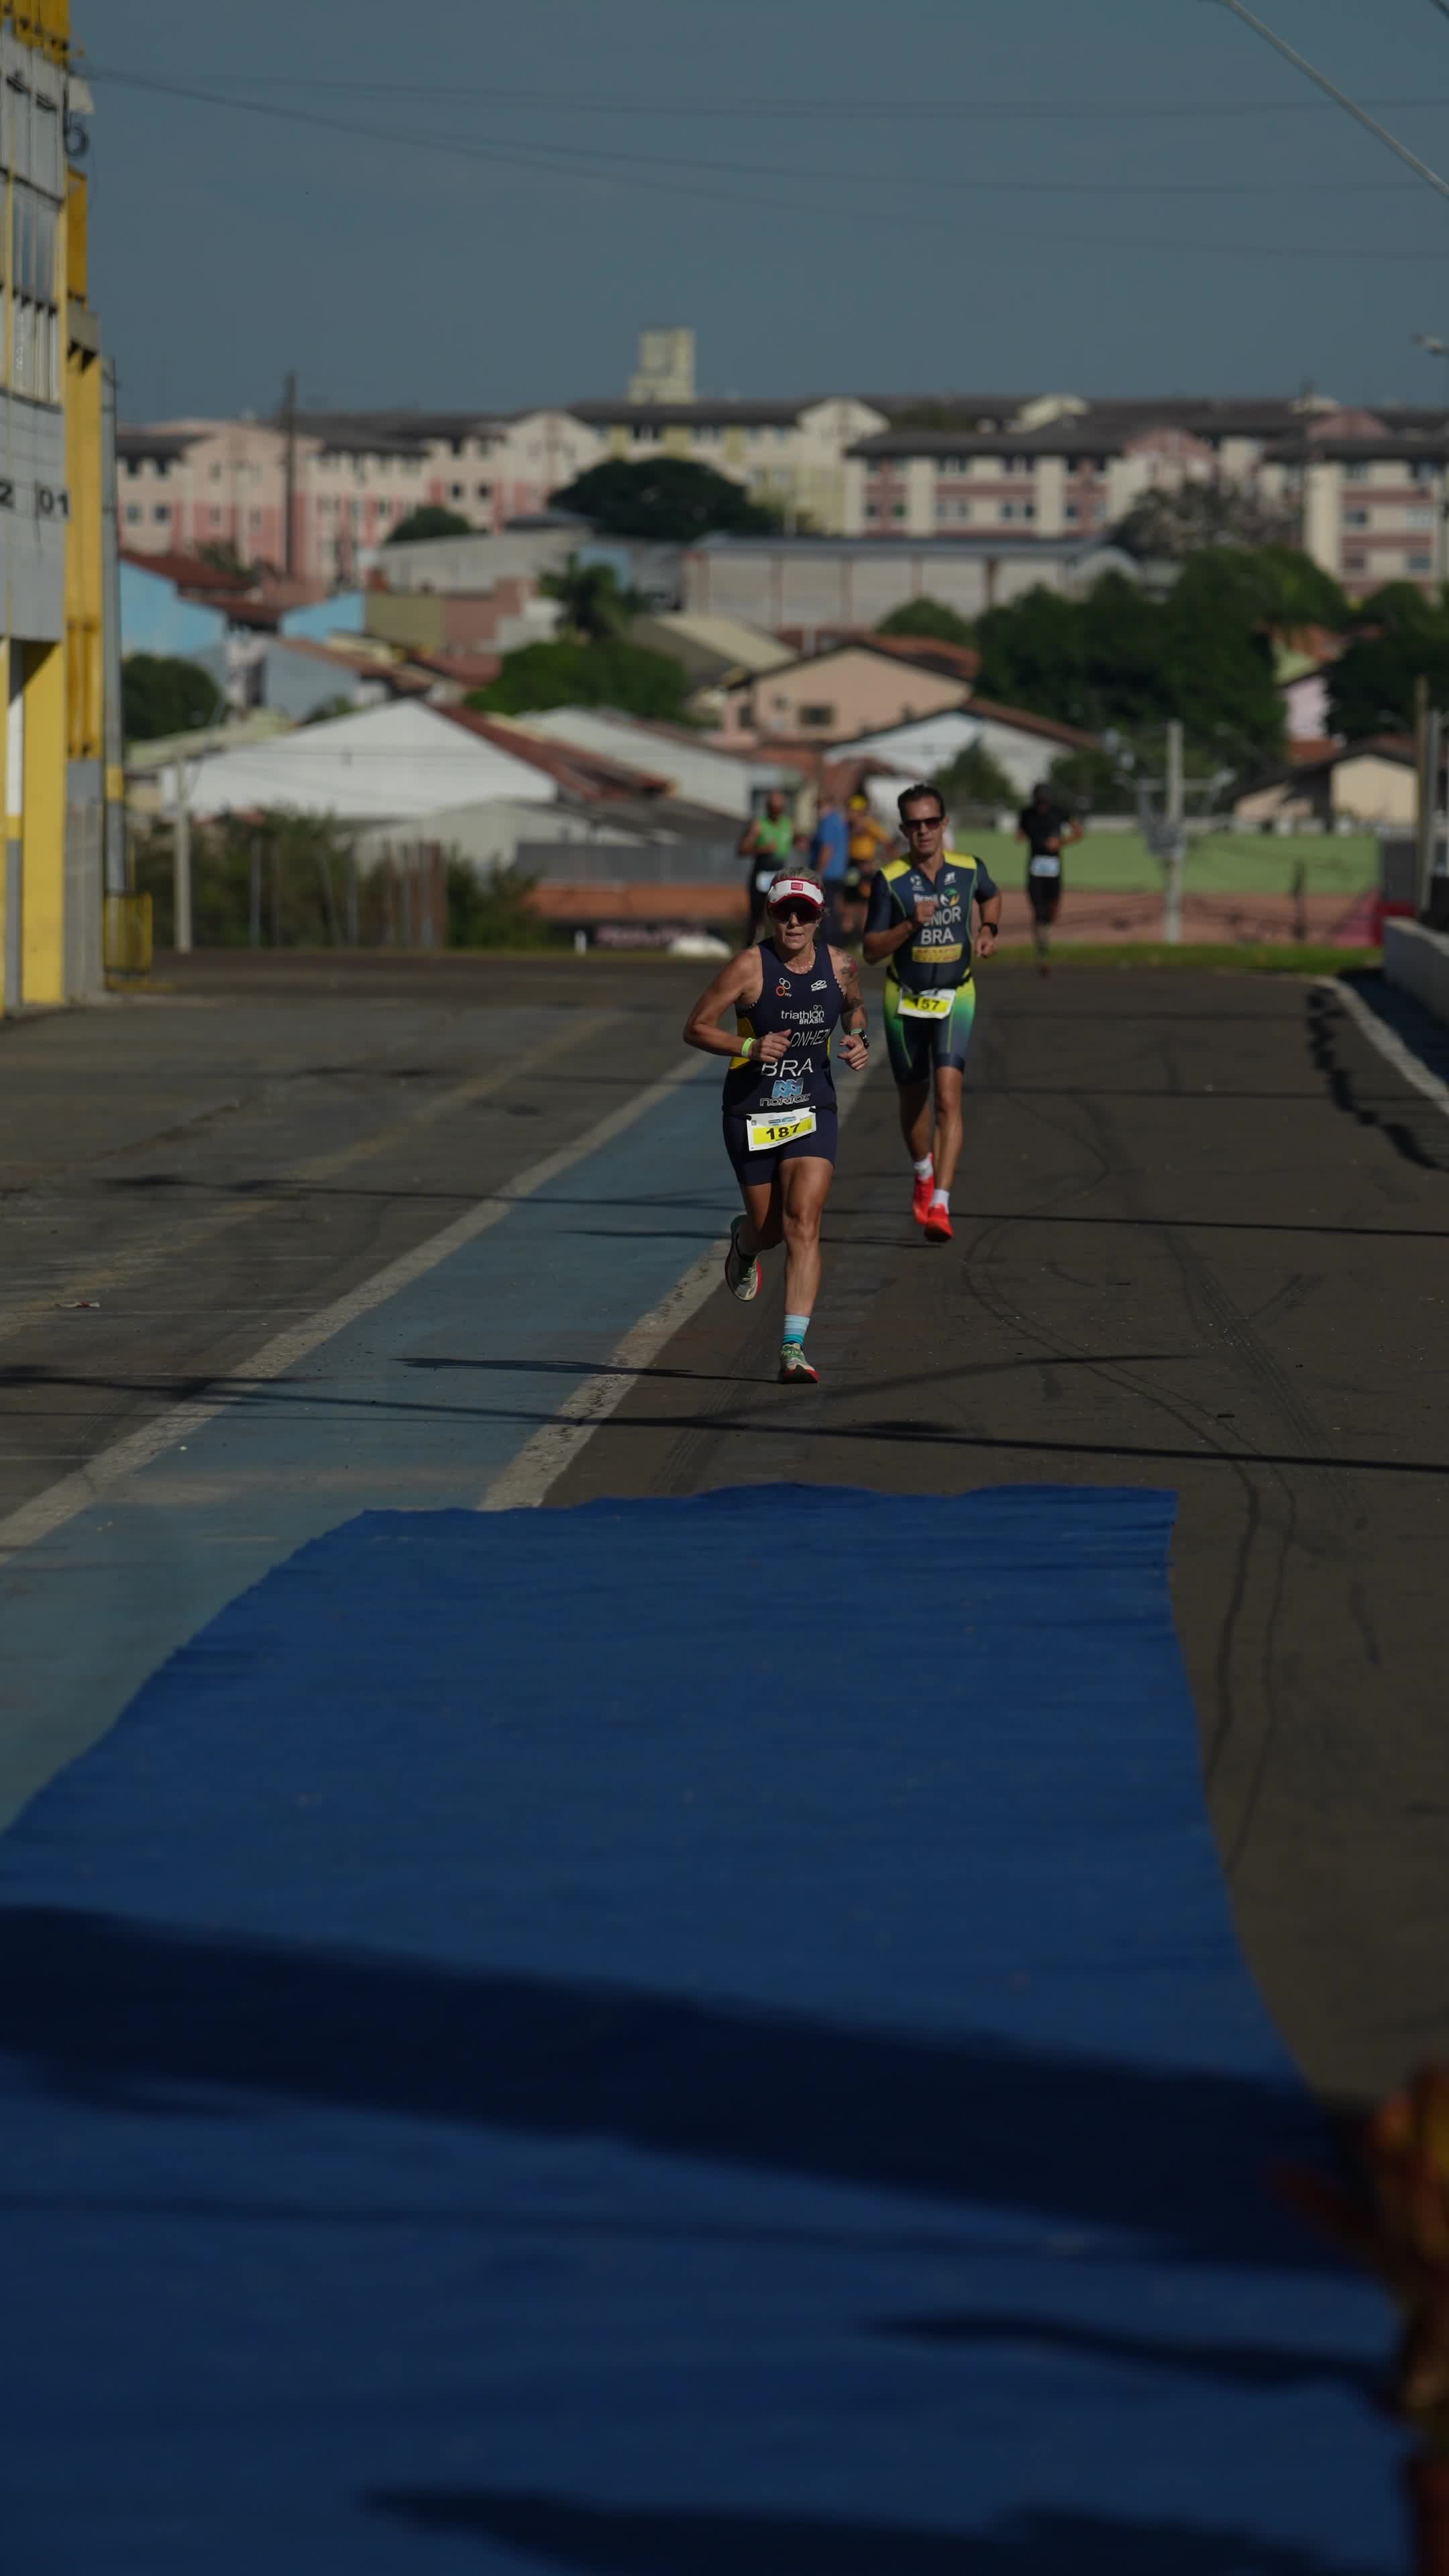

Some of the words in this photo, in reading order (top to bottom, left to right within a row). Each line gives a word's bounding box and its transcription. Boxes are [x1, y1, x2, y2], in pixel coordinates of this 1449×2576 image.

[39, 488, 69, 519] 01
[923, 906, 961, 926] NIOR
[921, 927, 955, 945] BRA
[781, 1009, 824, 1019] triathlon
[761, 1058, 813, 1077] BRA
[766, 1123, 800, 1140] 187
